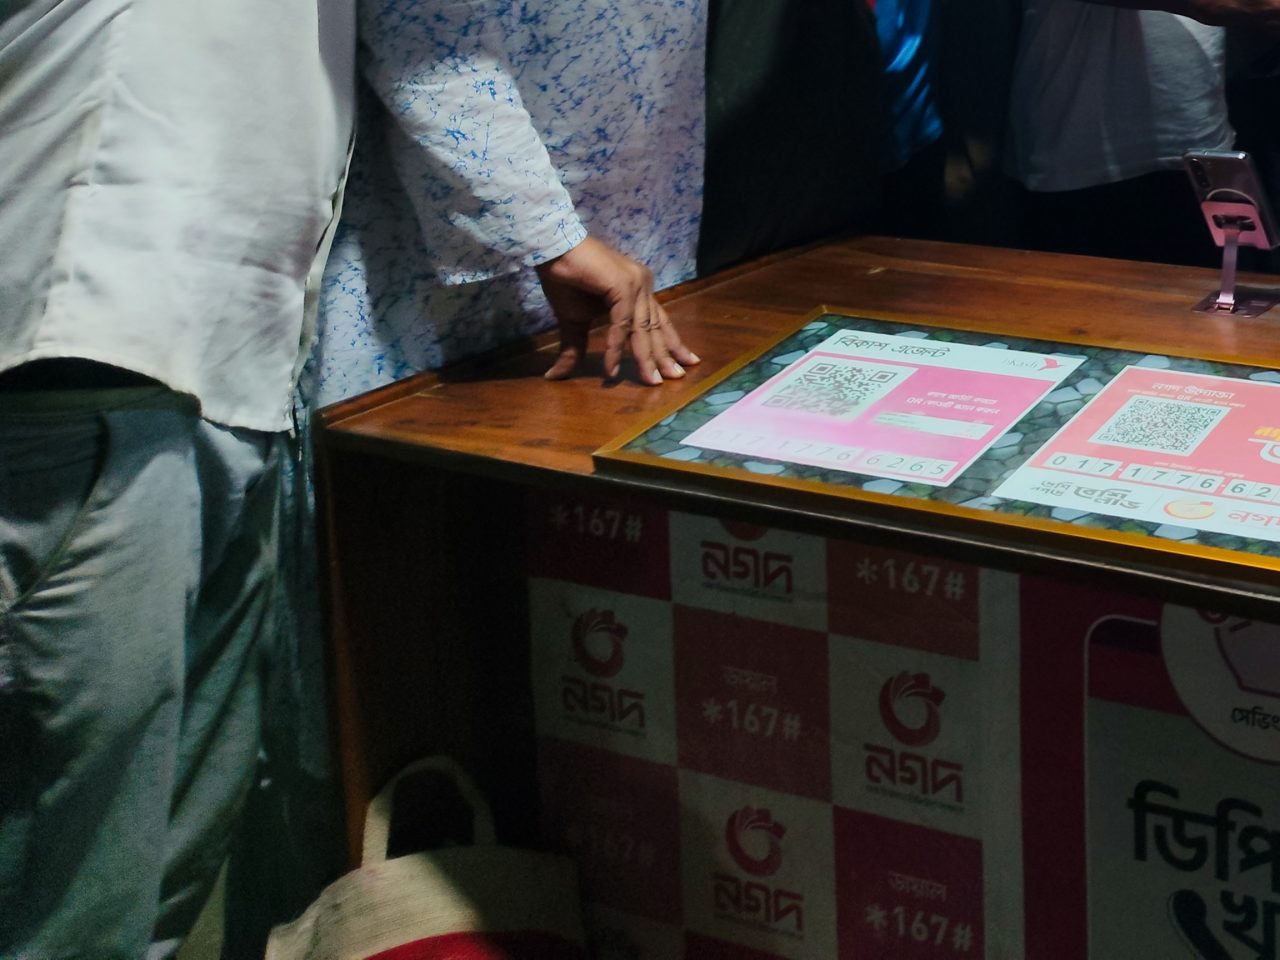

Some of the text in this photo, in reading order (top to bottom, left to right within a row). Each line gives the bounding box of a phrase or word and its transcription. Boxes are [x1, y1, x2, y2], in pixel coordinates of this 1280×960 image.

[835, 335, 951, 358] বিকাশ এজেন্ট
[701, 541, 794, 593] নগদ
[560, 675, 646, 729] নগদ
[863, 743, 964, 804] নগদ
[711, 872, 804, 933] নগদ
